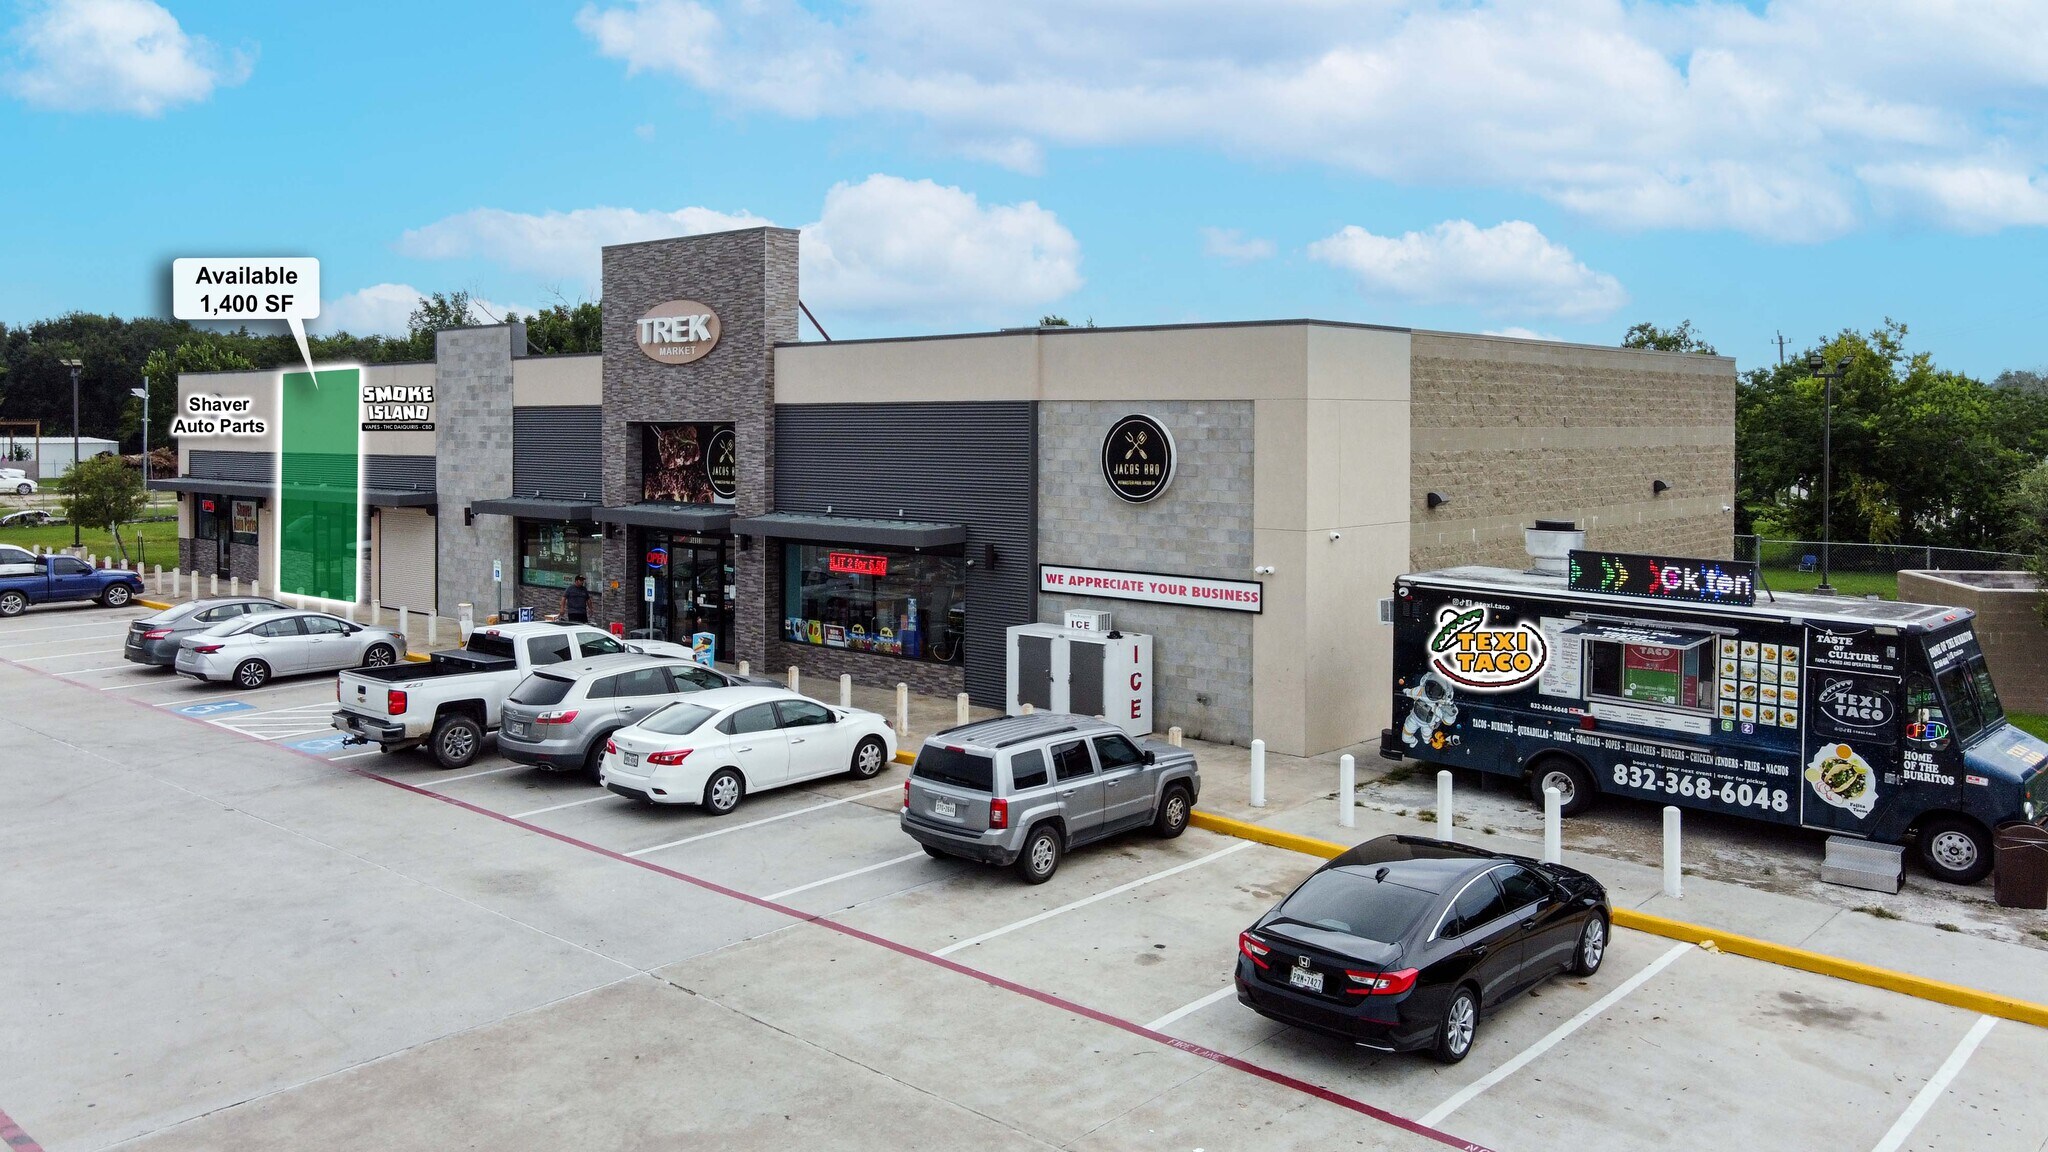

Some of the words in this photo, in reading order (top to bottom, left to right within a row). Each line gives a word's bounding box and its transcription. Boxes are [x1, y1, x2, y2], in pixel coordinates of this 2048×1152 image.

[636, 314, 712, 345] TREK
[659, 346, 696, 356] MARKET
[712, 466, 729, 476] JACOS
[1113, 464, 1140, 475] JACOS
[1144, 464, 1160, 476] BBQ
[647, 552, 668, 565] OPEN
[1045, 573, 1064, 585] WE
[1068, 575, 1144, 592] APPRECIATE
[1149, 582, 1187, 597] YOUR
[1192, 586, 1259, 603] BUSINESS
[1070, 620, 1090, 630] ICE
[1826, 628, 1833, 636] A
[1816, 634, 1854, 646] TASTE
[1640, 646, 1670, 657] TACO
[1828, 650, 1880, 662] CULTURE
[1130, 644, 1142, 720] ICE
[1835, 692, 1882, 708] TEXI
[1834, 704, 1884, 720] TACO
[1906, 724, 1948, 738] OPEN
[1472, 718, 1488, 730] TACOS
[1490, 721, 1514, 734] BURRITOS
[1517, 725, 1549, 739] QUESADILLAS
[1553, 731, 1572, 742] TORTAS
[1605, 738, 1620, 751] SOPES
[1625, 742, 1656, 756] HUARACHES
[1660, 747, 1685, 761] BURGERS
[1690, 752, 1714, 765] CHICKEN
[1714, 754, 1738, 769] TENDERS
[1744, 760, 1760, 772] FRIES
[1765, 763, 1790, 777] NACHOS
[1904, 750, 1932, 763] HOME
[1904, 760, 1918, 770] OF
[1919, 762, 1939, 774] THE
[1717, 772, 1734, 780] order
[1736, 774, 1744, 782] for
[1746, 776, 1768, 786] pickup
[1903, 770, 1955, 786] BURRITOS
[1613, 764, 1789, 812] 832-368-6048
[1167, 1038, 1194, 1051] FIRE
[1192, 1047, 1225, 1060] LANE
